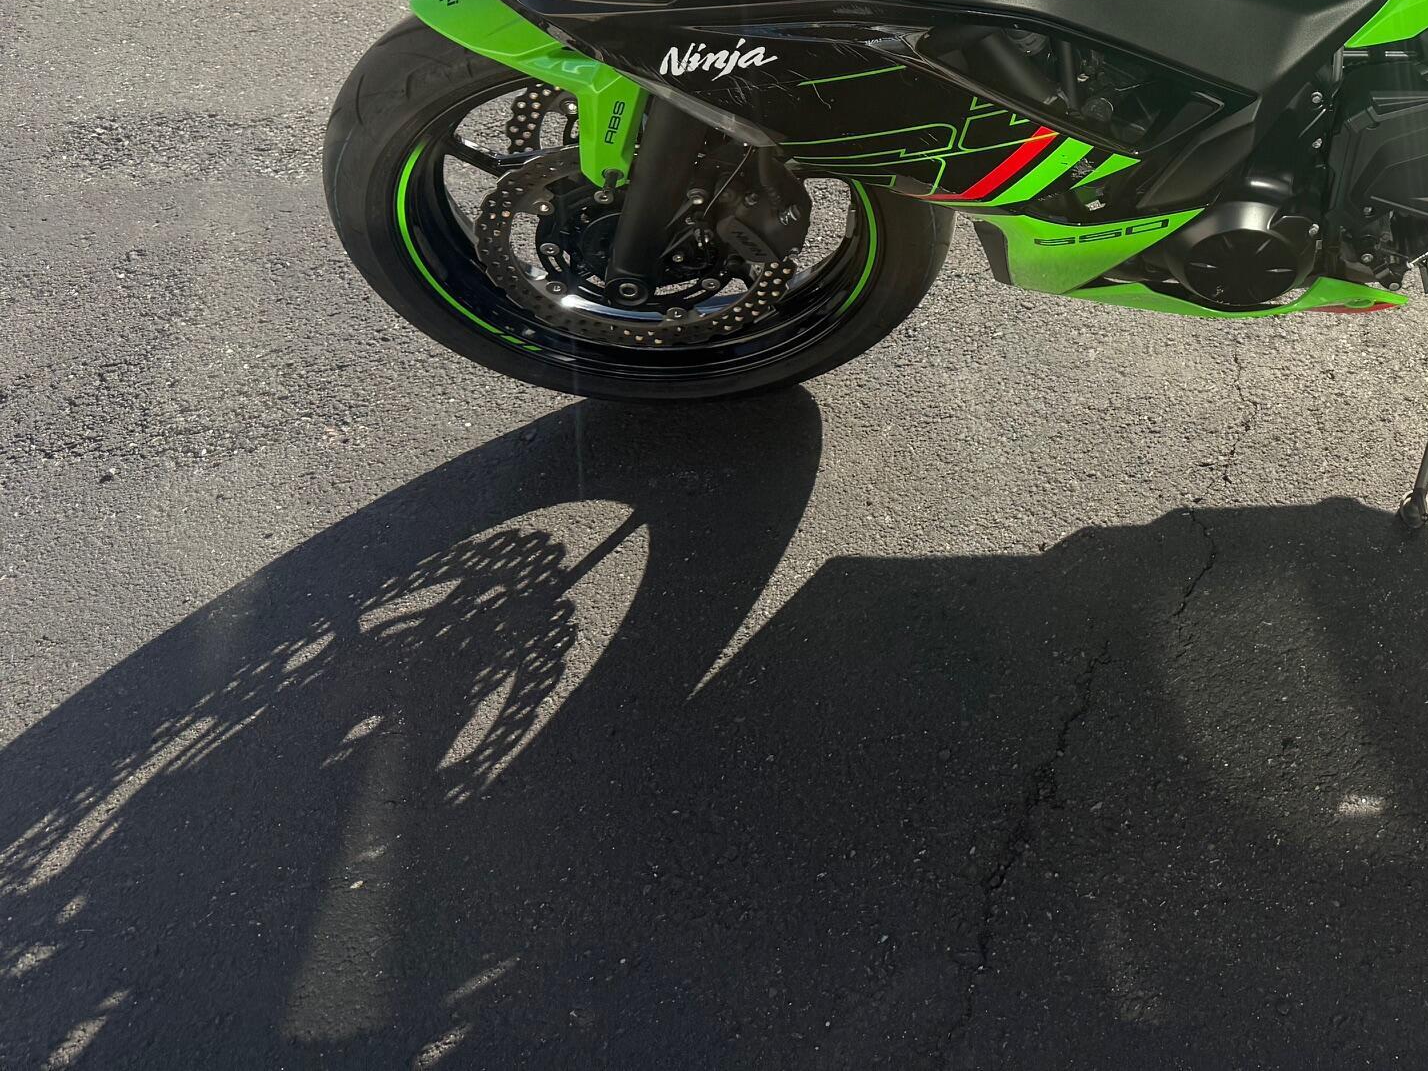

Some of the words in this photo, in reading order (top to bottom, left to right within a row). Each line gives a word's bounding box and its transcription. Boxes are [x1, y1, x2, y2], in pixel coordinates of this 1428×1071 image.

[659, 37, 779, 82] Ninja
[604, 100, 626, 145] ABS
[1033, 218, 1170, 247] 650
